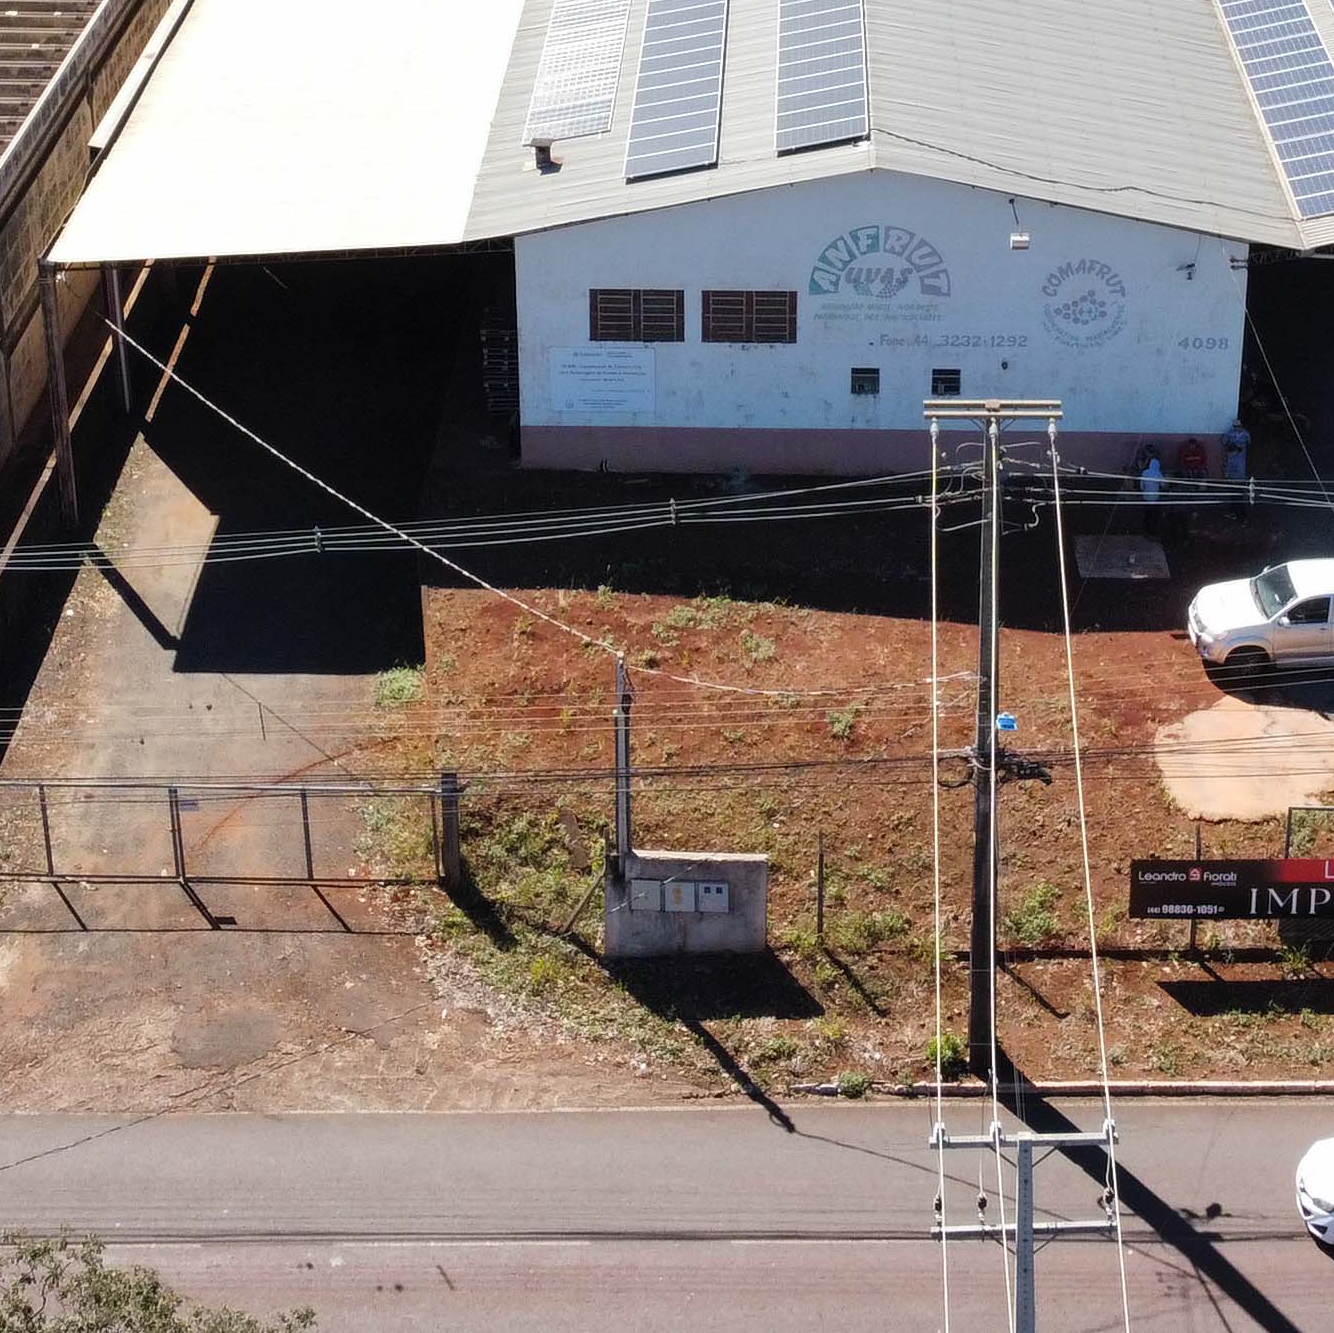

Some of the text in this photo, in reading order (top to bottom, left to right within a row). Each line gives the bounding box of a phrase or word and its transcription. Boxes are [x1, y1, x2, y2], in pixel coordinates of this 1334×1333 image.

[810, 226, 950, 295] ANFRUT
[1042, 258, 1125, 297] COMAFRUT
[1177, 337, 1229, 351] 4098
[1138, 871, 1238, 882] Leandro Fiorati
